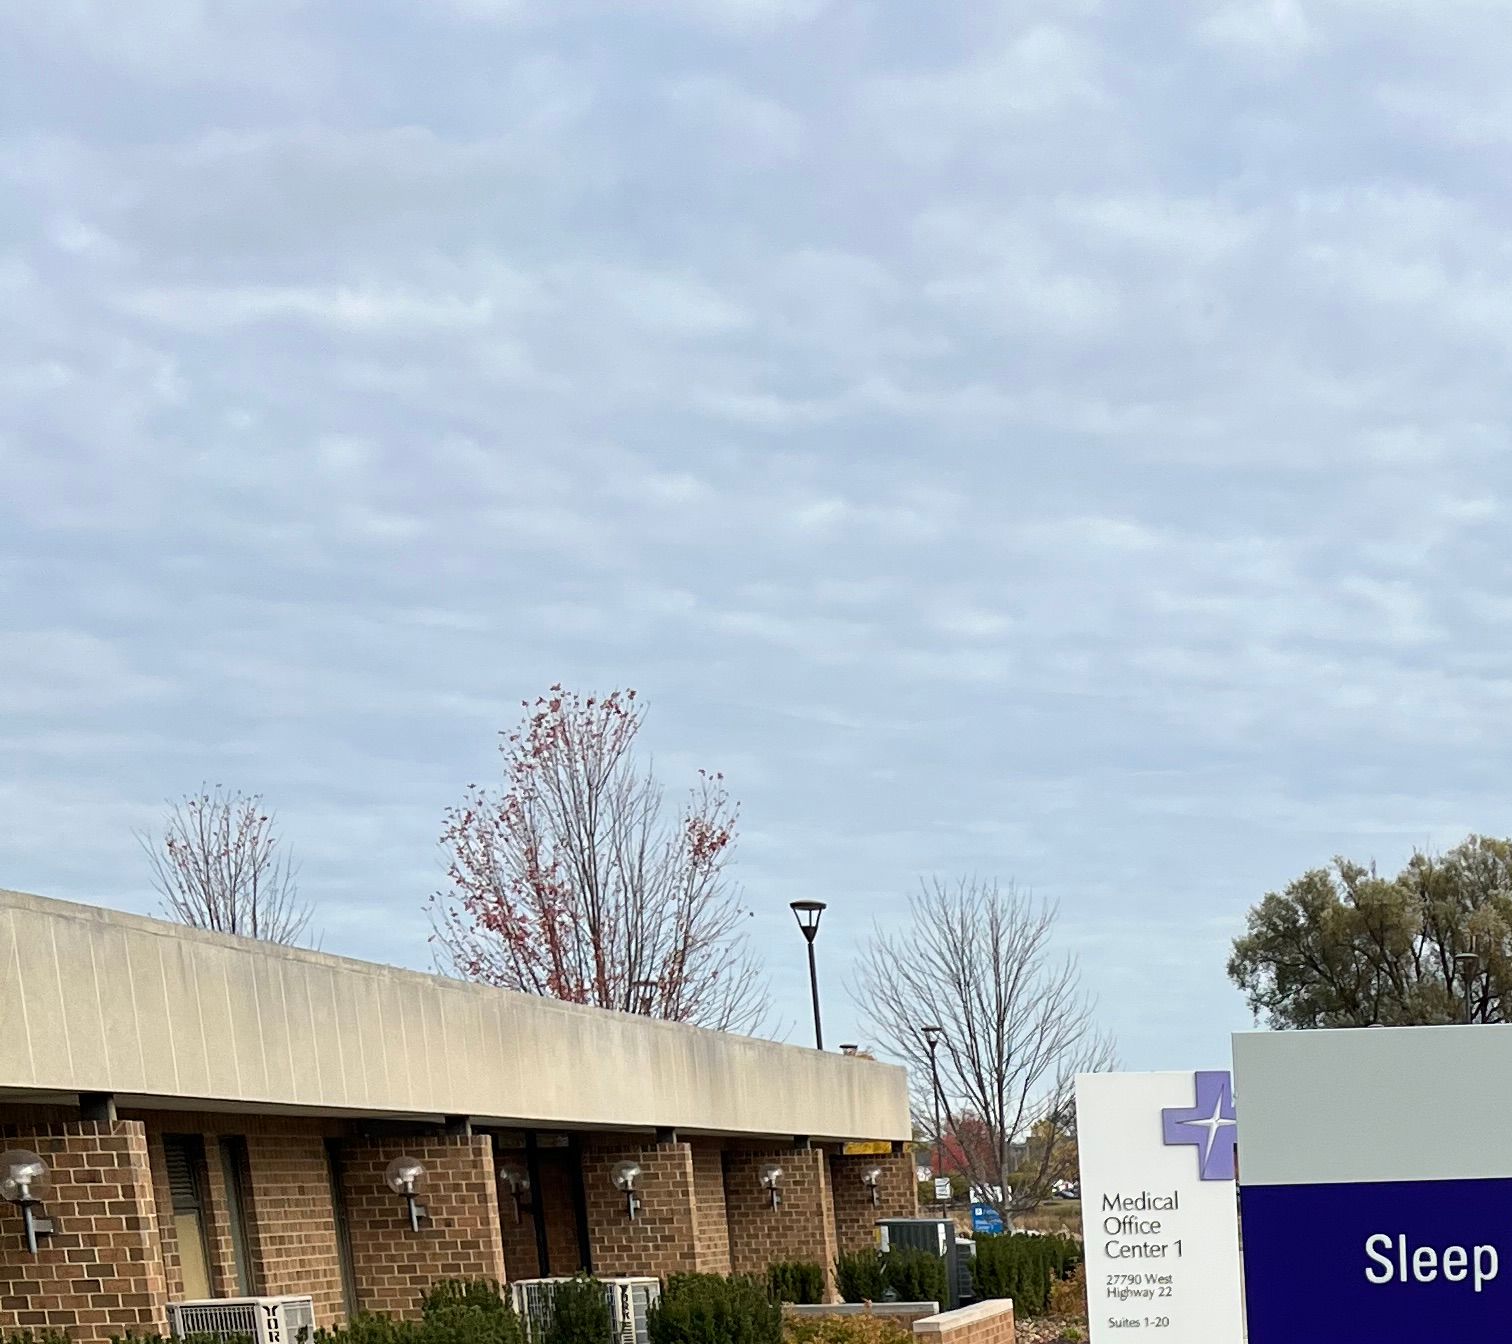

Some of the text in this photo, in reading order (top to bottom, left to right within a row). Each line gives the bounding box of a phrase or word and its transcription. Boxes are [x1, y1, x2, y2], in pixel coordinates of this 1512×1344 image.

[1102, 1189, 1179, 1211] Medical
[1104, 1215, 1161, 1236] Office
[1105, 1239, 1182, 1259] Center 1
[1365, 1233, 1499, 1292] Sleep
[1106, 1273, 1173, 1286] 27790 West
[1107, 1286, 1172, 1301] Highway 22
[1108, 1316, 1170, 1328] Suites 1-20
